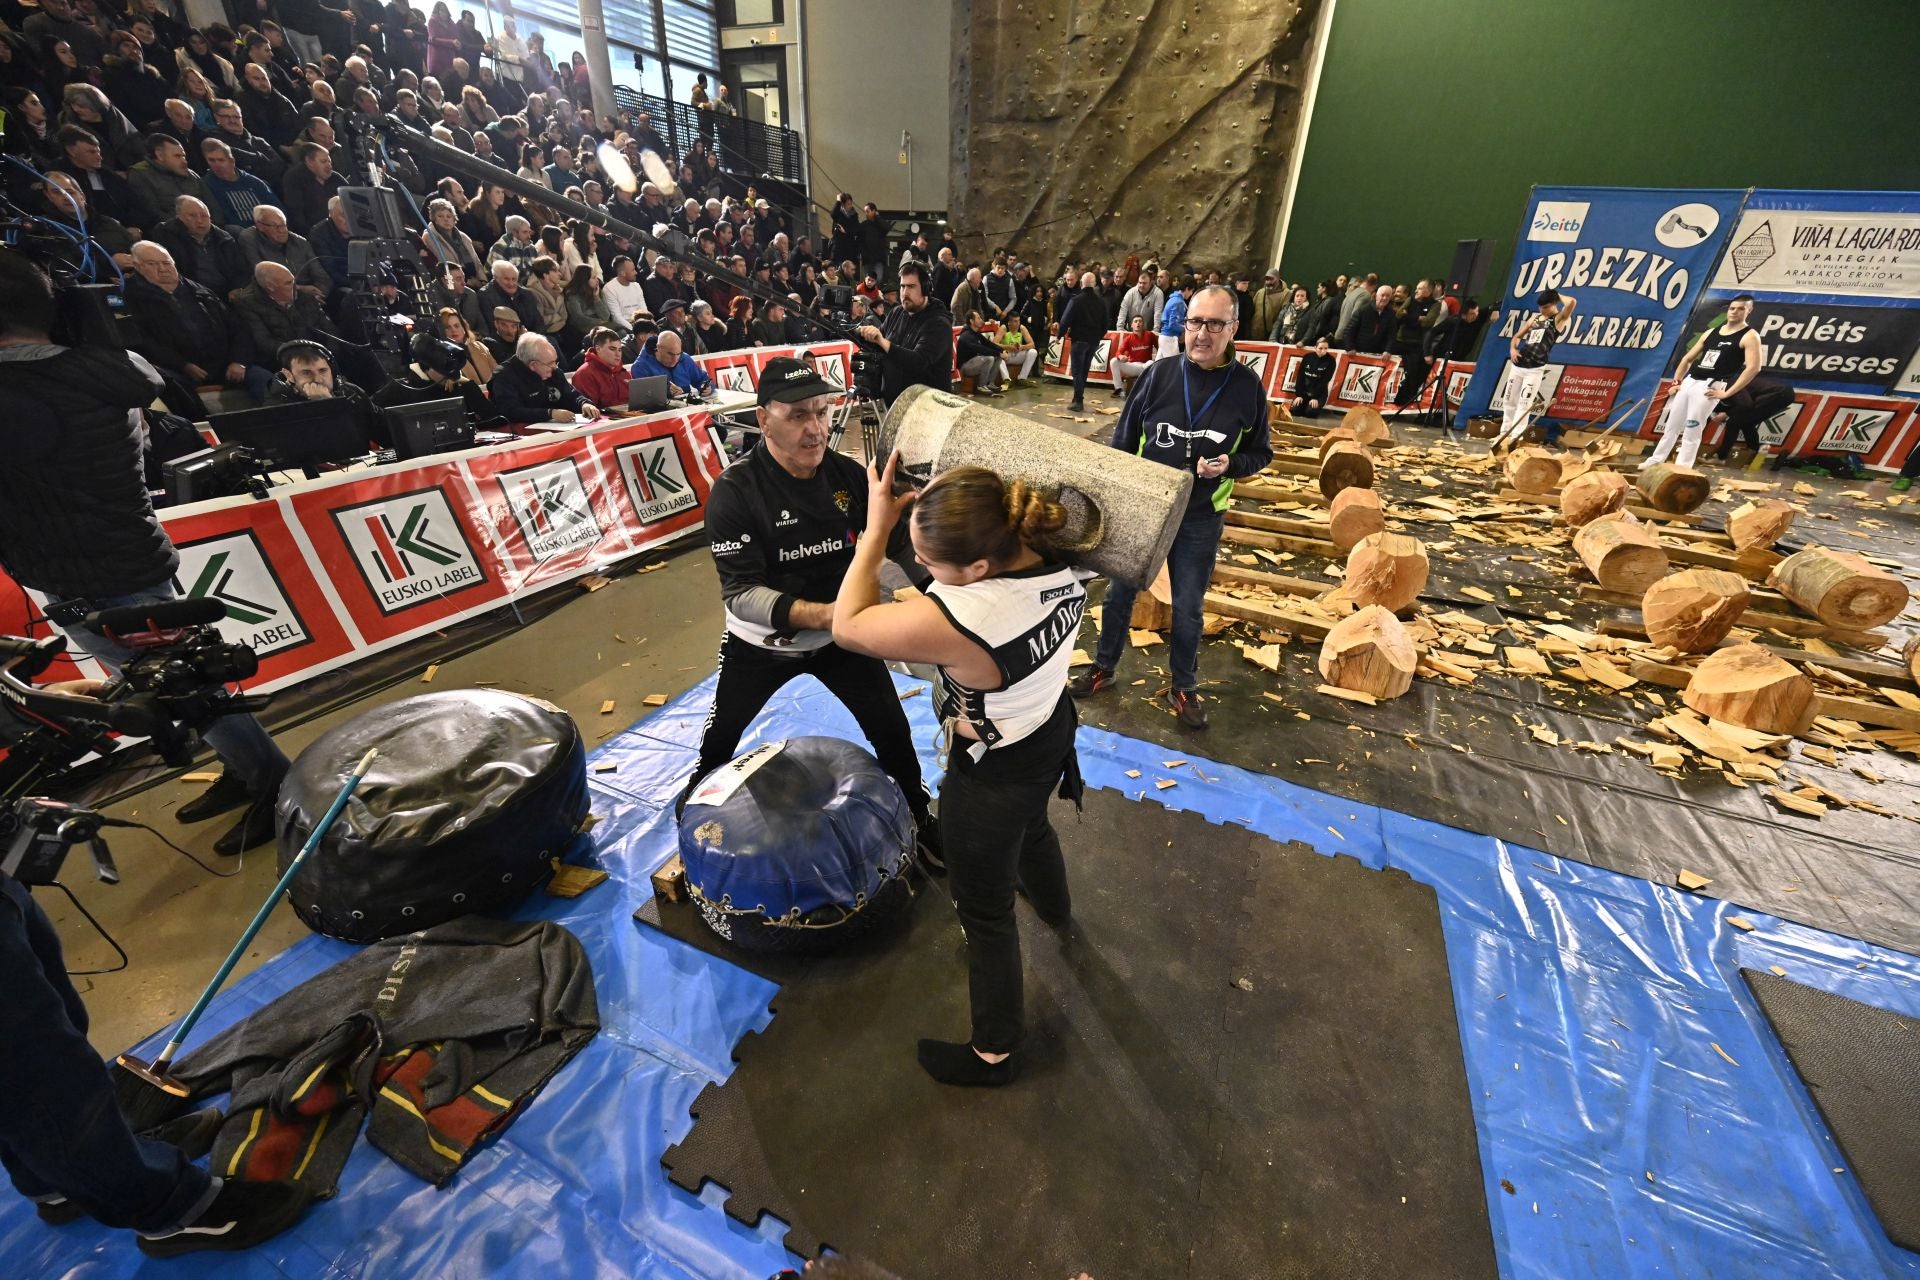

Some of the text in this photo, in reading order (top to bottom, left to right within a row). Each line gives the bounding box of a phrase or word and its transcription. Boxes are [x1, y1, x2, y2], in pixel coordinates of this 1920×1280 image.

[1550, 218, 1581, 232] eitb
[1791, 224, 1834, 249] VIÑA
[1802, 253, 1900, 264] UPATEGIAK
[1513, 247, 1689, 310] URREZKO
[1784, 269, 1842, 278] ARABAKO
[1759, 314, 1868, 343] Paléts
[858, 361, 865, 370] 3
[1562, 375, 1618, 388] Goi-mailako
[1563, 386, 1609, 397] elikagaiak
[1844, 443, 1869, 451] LABEL
[639, 494, 695, 520] EUSKO LABEL
[775, 517, 799, 528] VIATOR
[533, 526, 599, 554] EUSKO LABEL
[711, 540, 743, 552] izeta
[779, 537, 843, 562] helvetia
[382, 565, 480, 605] EUSKO LABEL
[240, 622, 301, 652] LABEL
